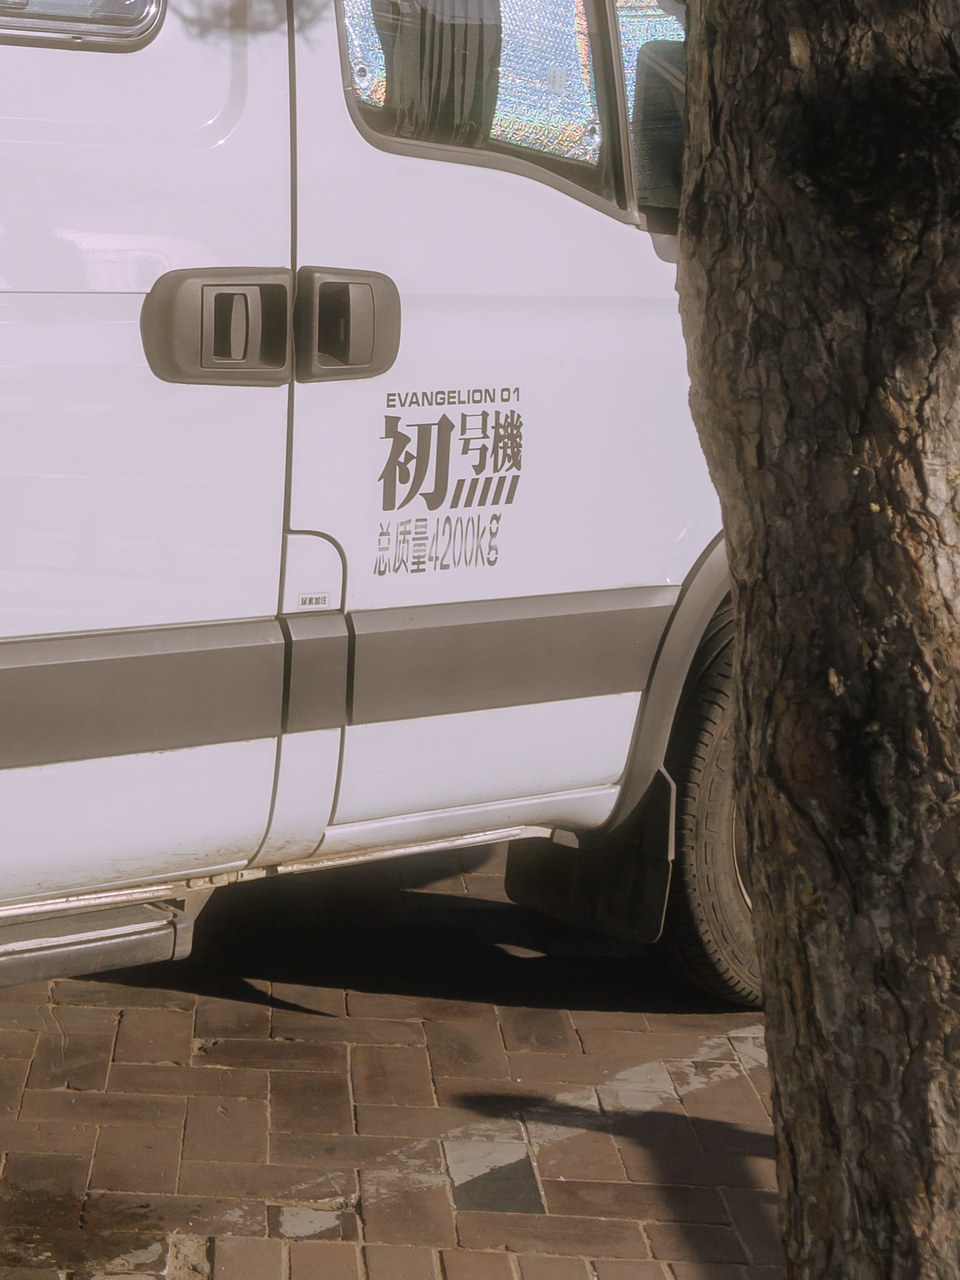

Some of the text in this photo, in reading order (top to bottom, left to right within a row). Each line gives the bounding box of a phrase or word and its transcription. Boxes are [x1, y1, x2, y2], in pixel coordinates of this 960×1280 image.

[386, 387, 520, 408] EVANGELION 01
[377, 409, 524, 511] 初号機
